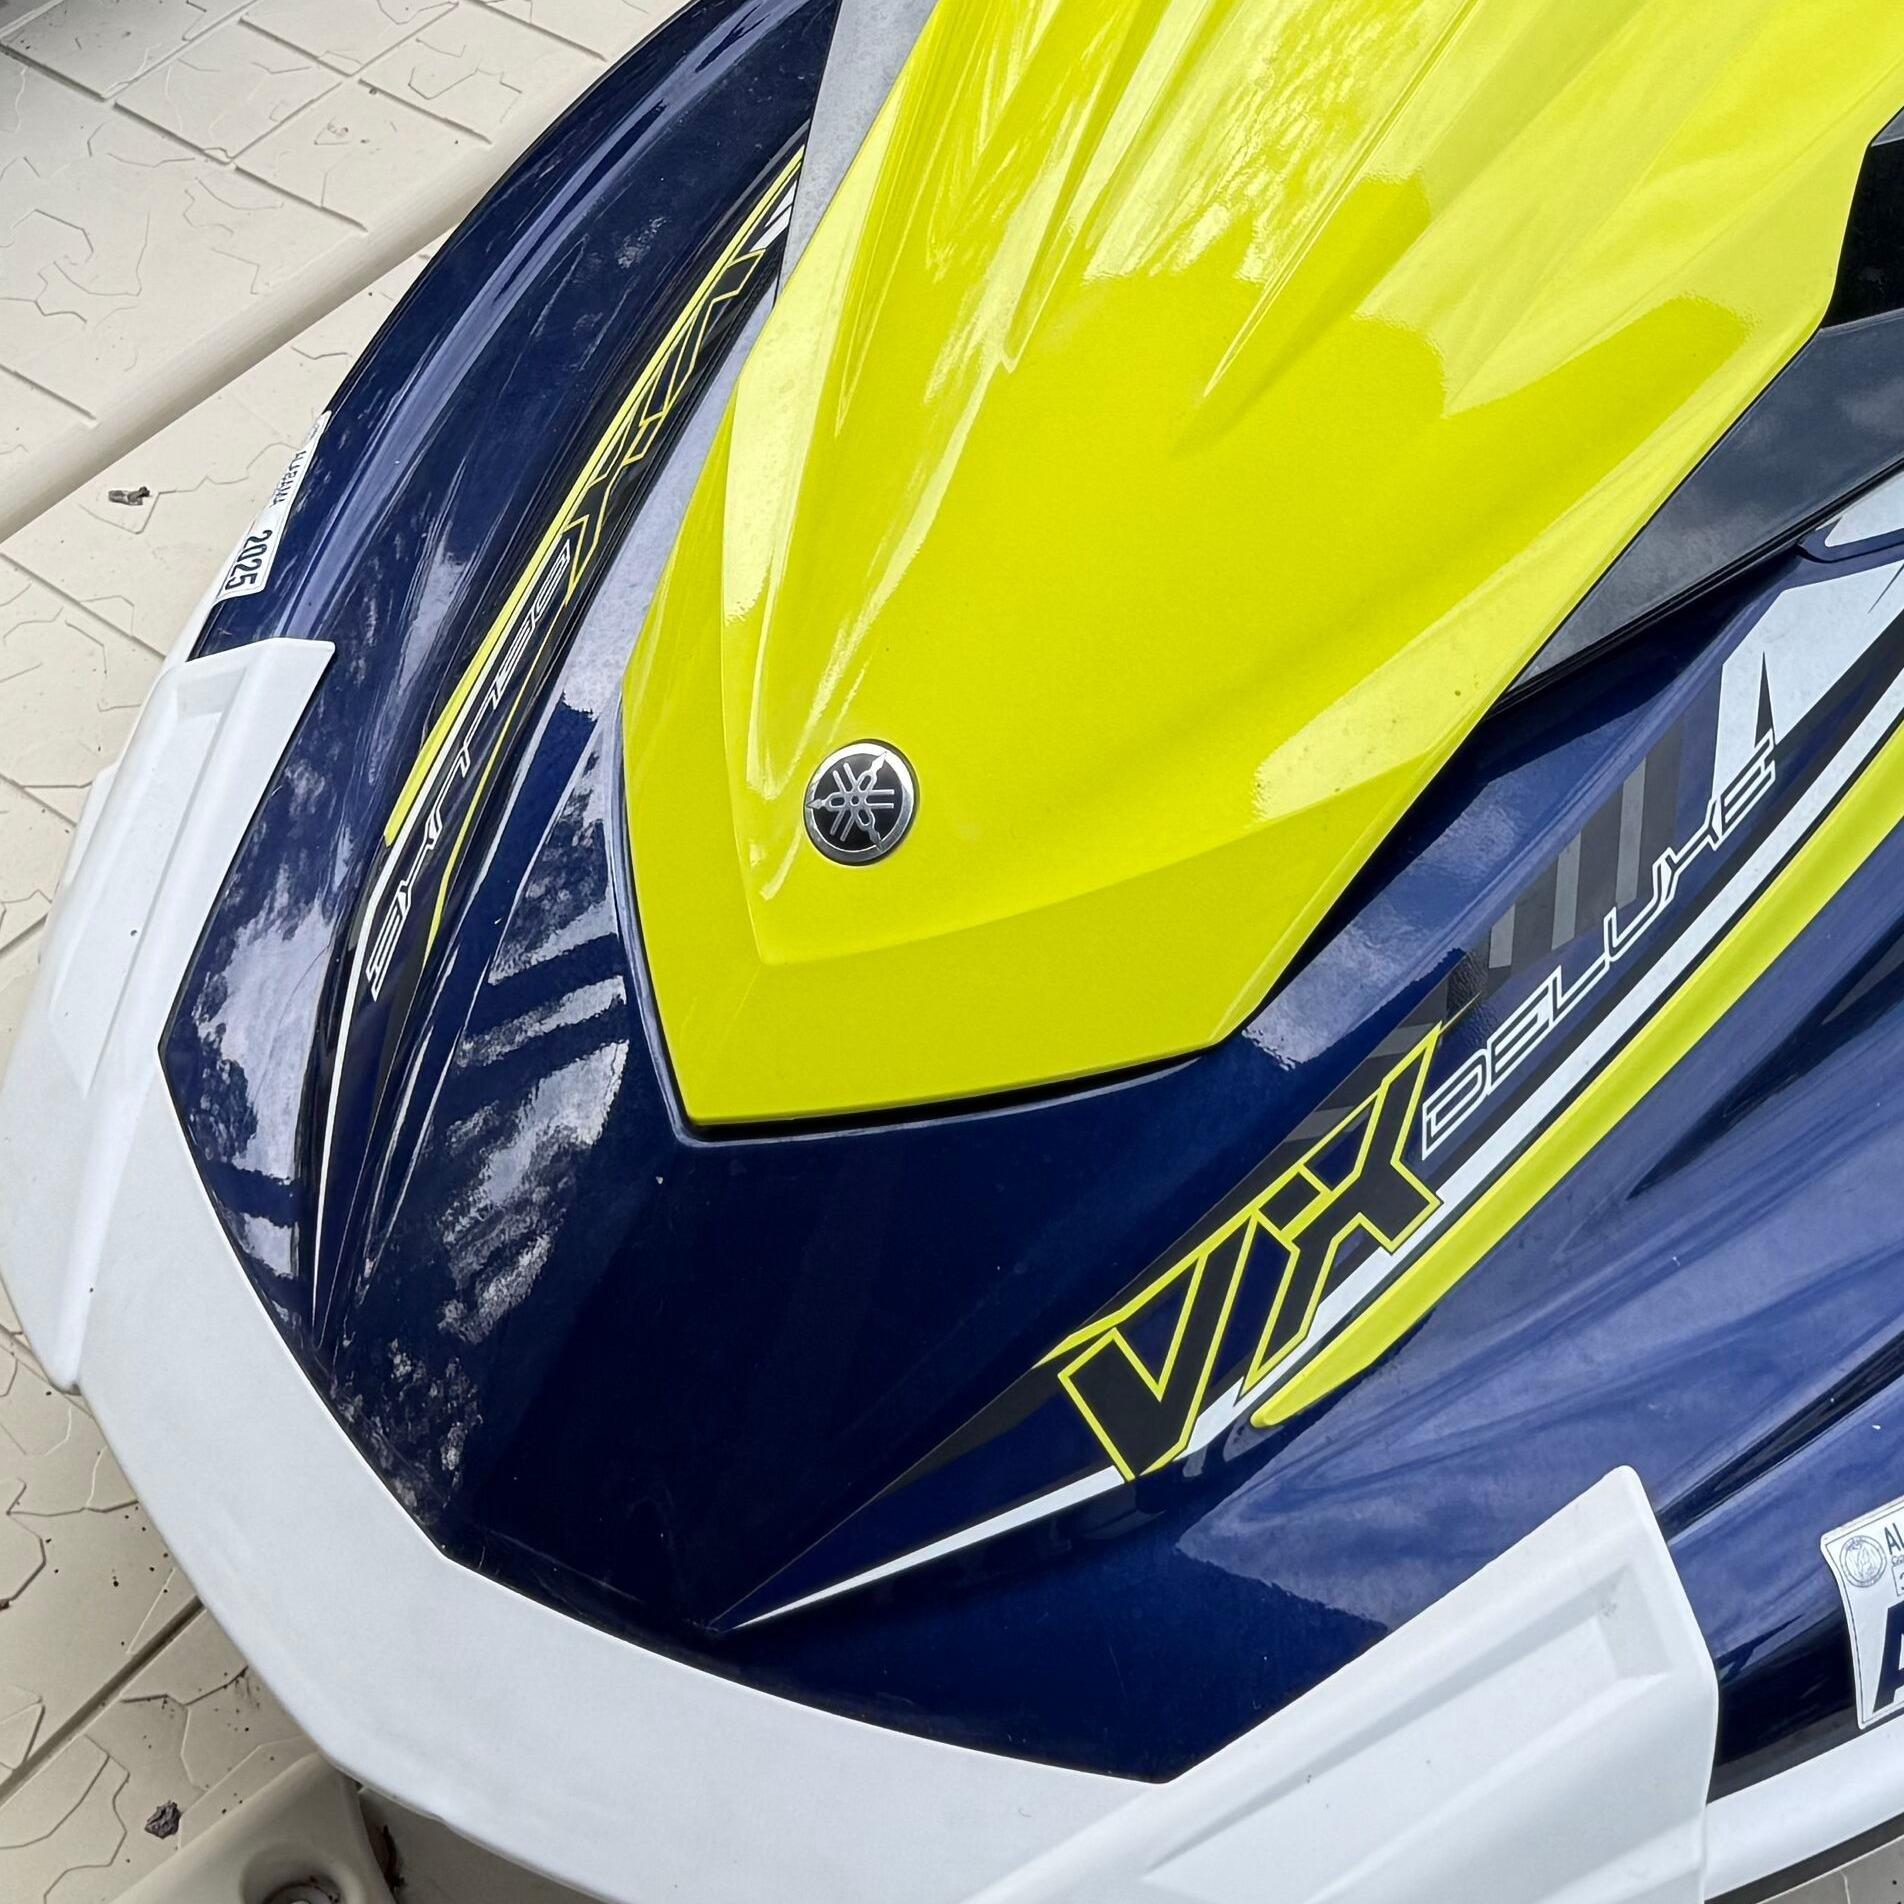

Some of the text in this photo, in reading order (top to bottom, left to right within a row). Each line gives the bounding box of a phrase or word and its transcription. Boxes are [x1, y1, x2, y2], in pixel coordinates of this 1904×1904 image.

[224, 529, 273, 590] 2025
[1058, 729, 1775, 1482] VX DELUXE
